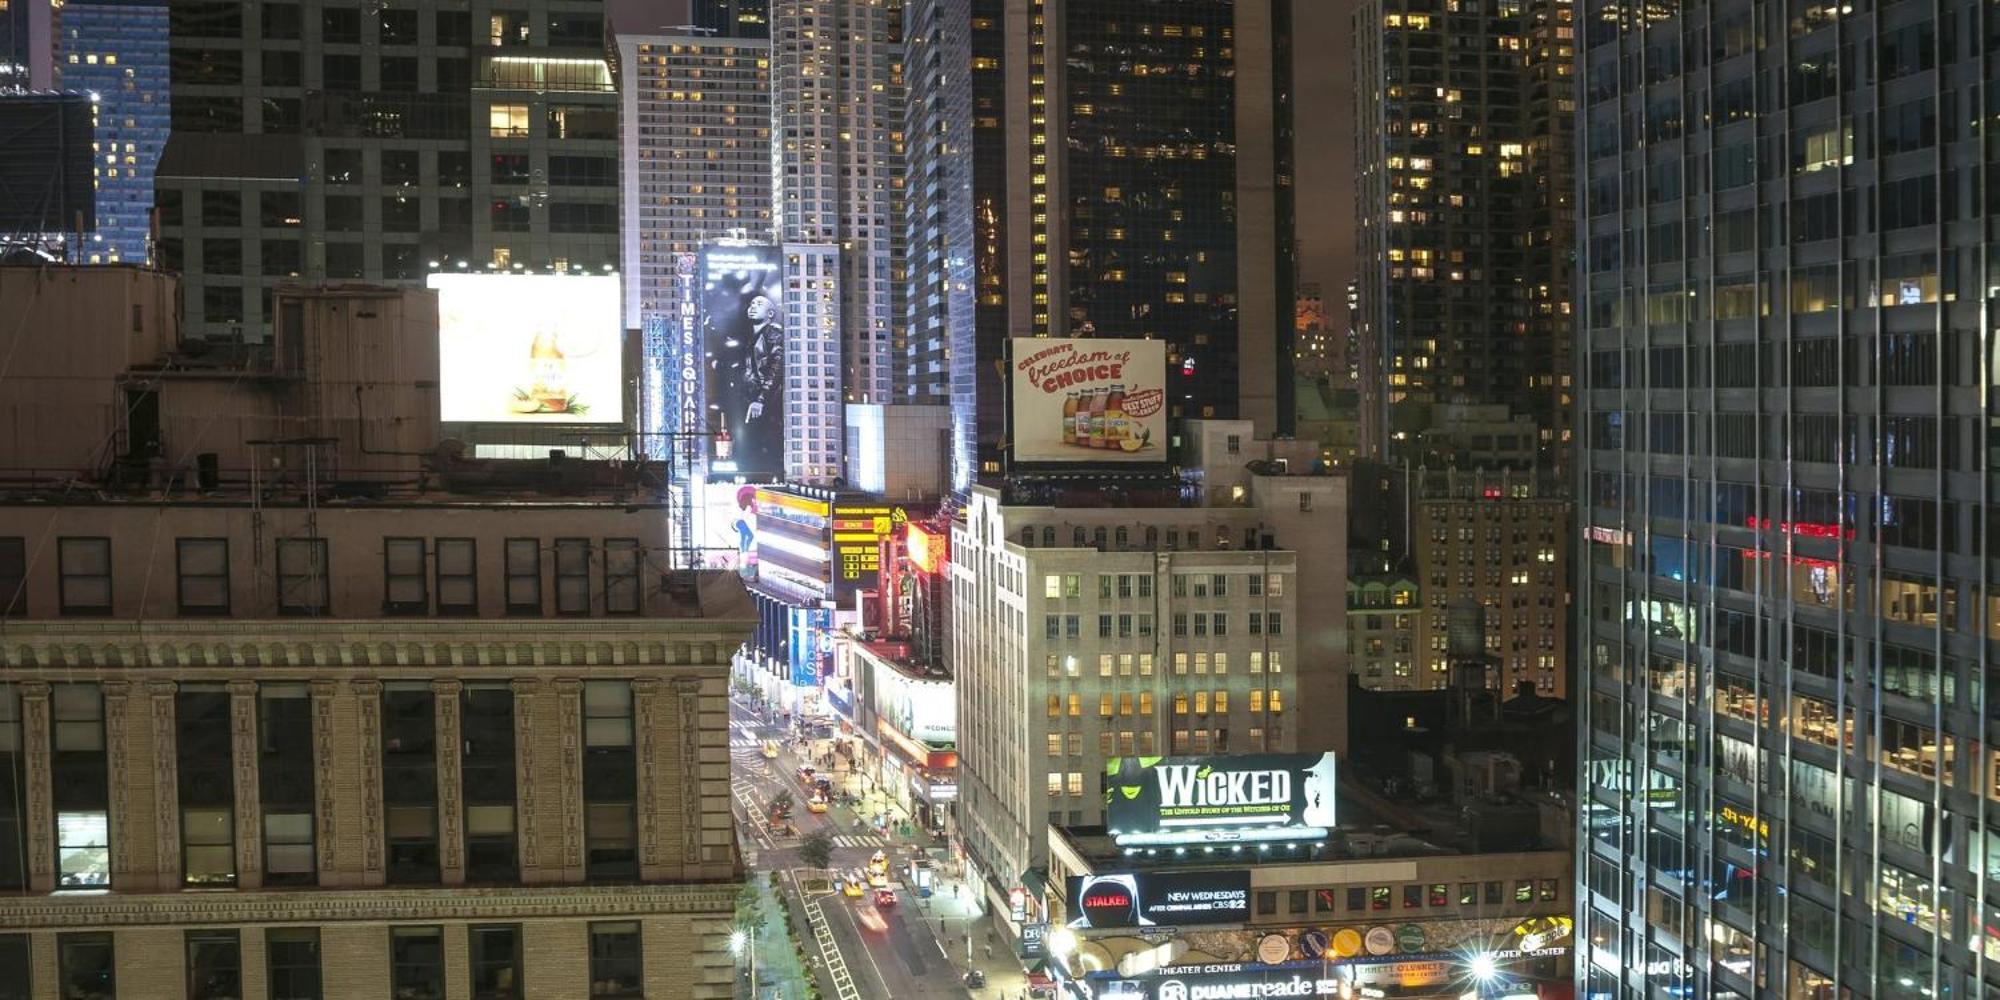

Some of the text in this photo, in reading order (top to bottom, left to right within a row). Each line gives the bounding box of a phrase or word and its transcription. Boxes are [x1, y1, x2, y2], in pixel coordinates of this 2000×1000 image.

[681, 274, 697, 439] TIMES SQUARE
[1017, 343, 1074, 371] CELEBRATE
[1028, 350, 1131, 388] freedom of
[1042, 363, 1123, 394] CHOICE
[1084, 894, 1130, 908] STALKER
[1167, 890, 1246, 902] NEW WEDNESDAYS
[1529, 947, 1565, 957] CENTER
[1158, 963, 1242, 976] THEATER CENTER
